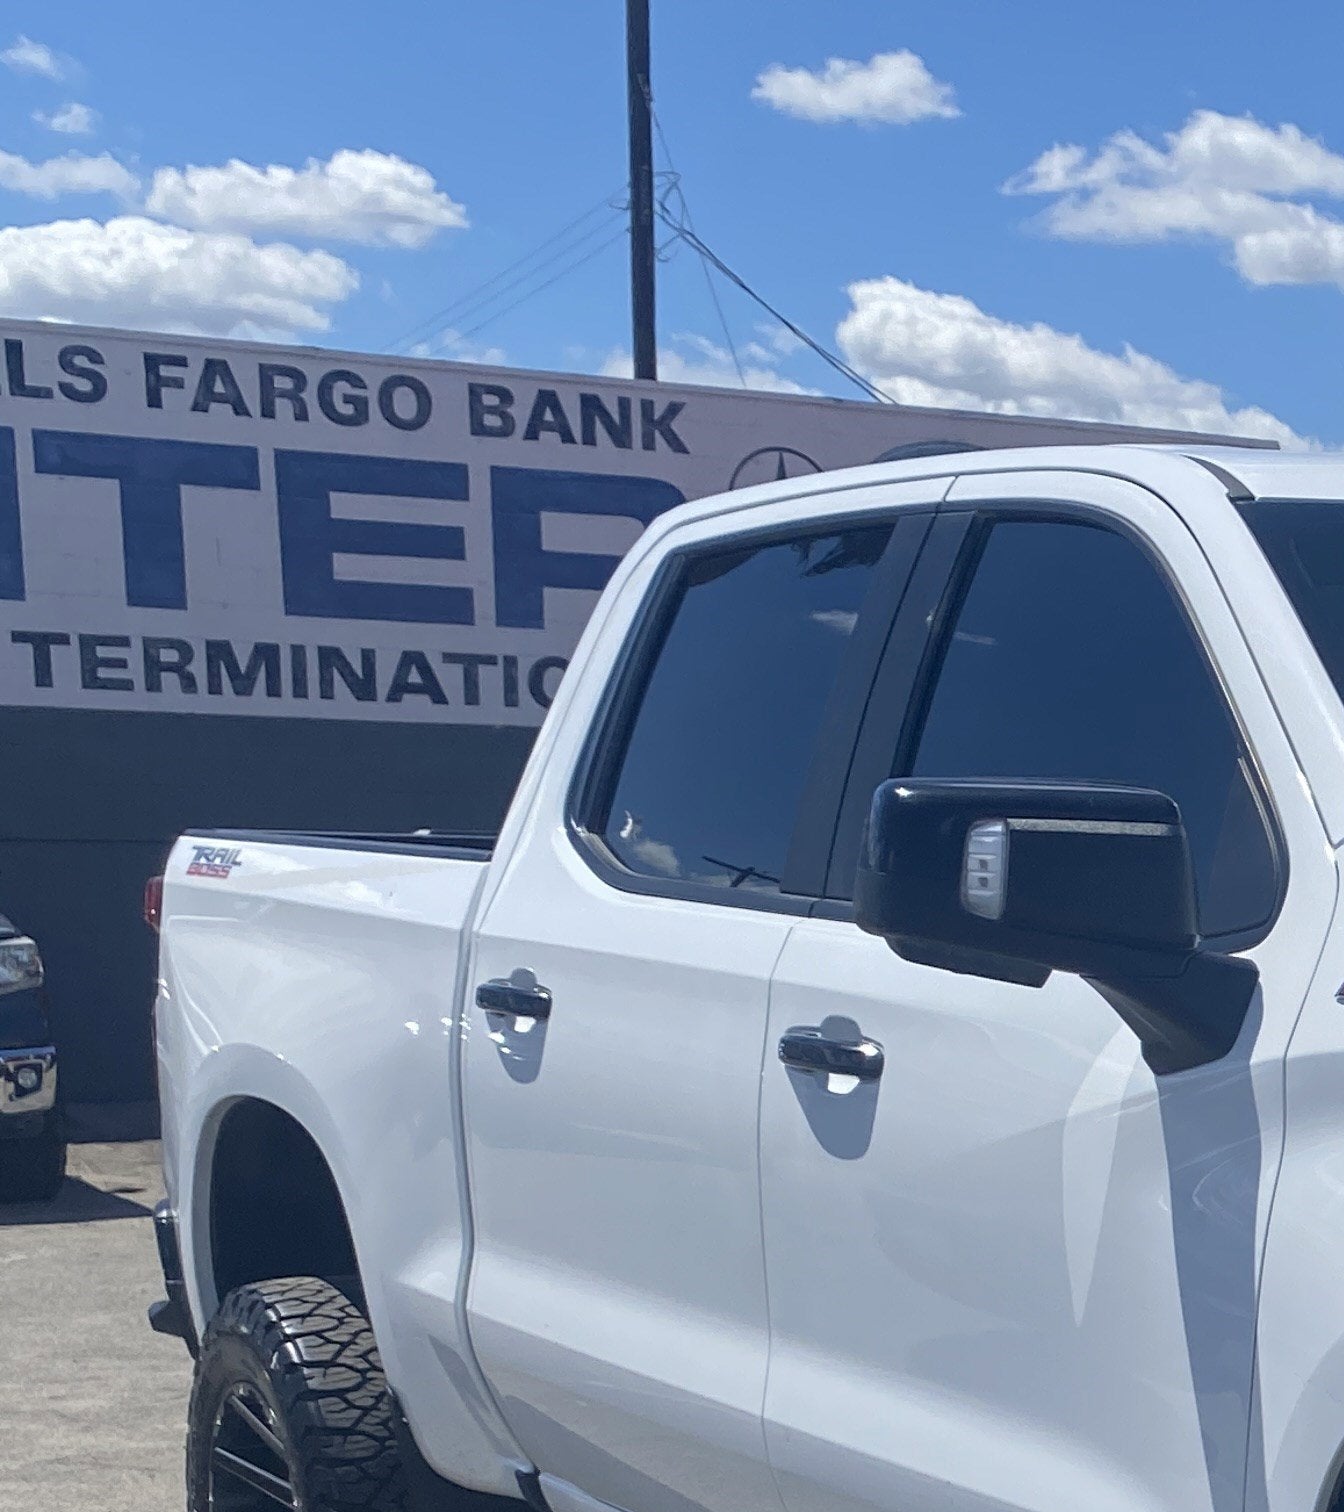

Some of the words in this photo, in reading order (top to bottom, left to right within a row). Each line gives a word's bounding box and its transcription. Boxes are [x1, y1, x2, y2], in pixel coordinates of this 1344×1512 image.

[143, 350, 432, 431] FARGO
[468, 382, 691, 455] BANK
[192, 845, 242, 866] TRAIL
